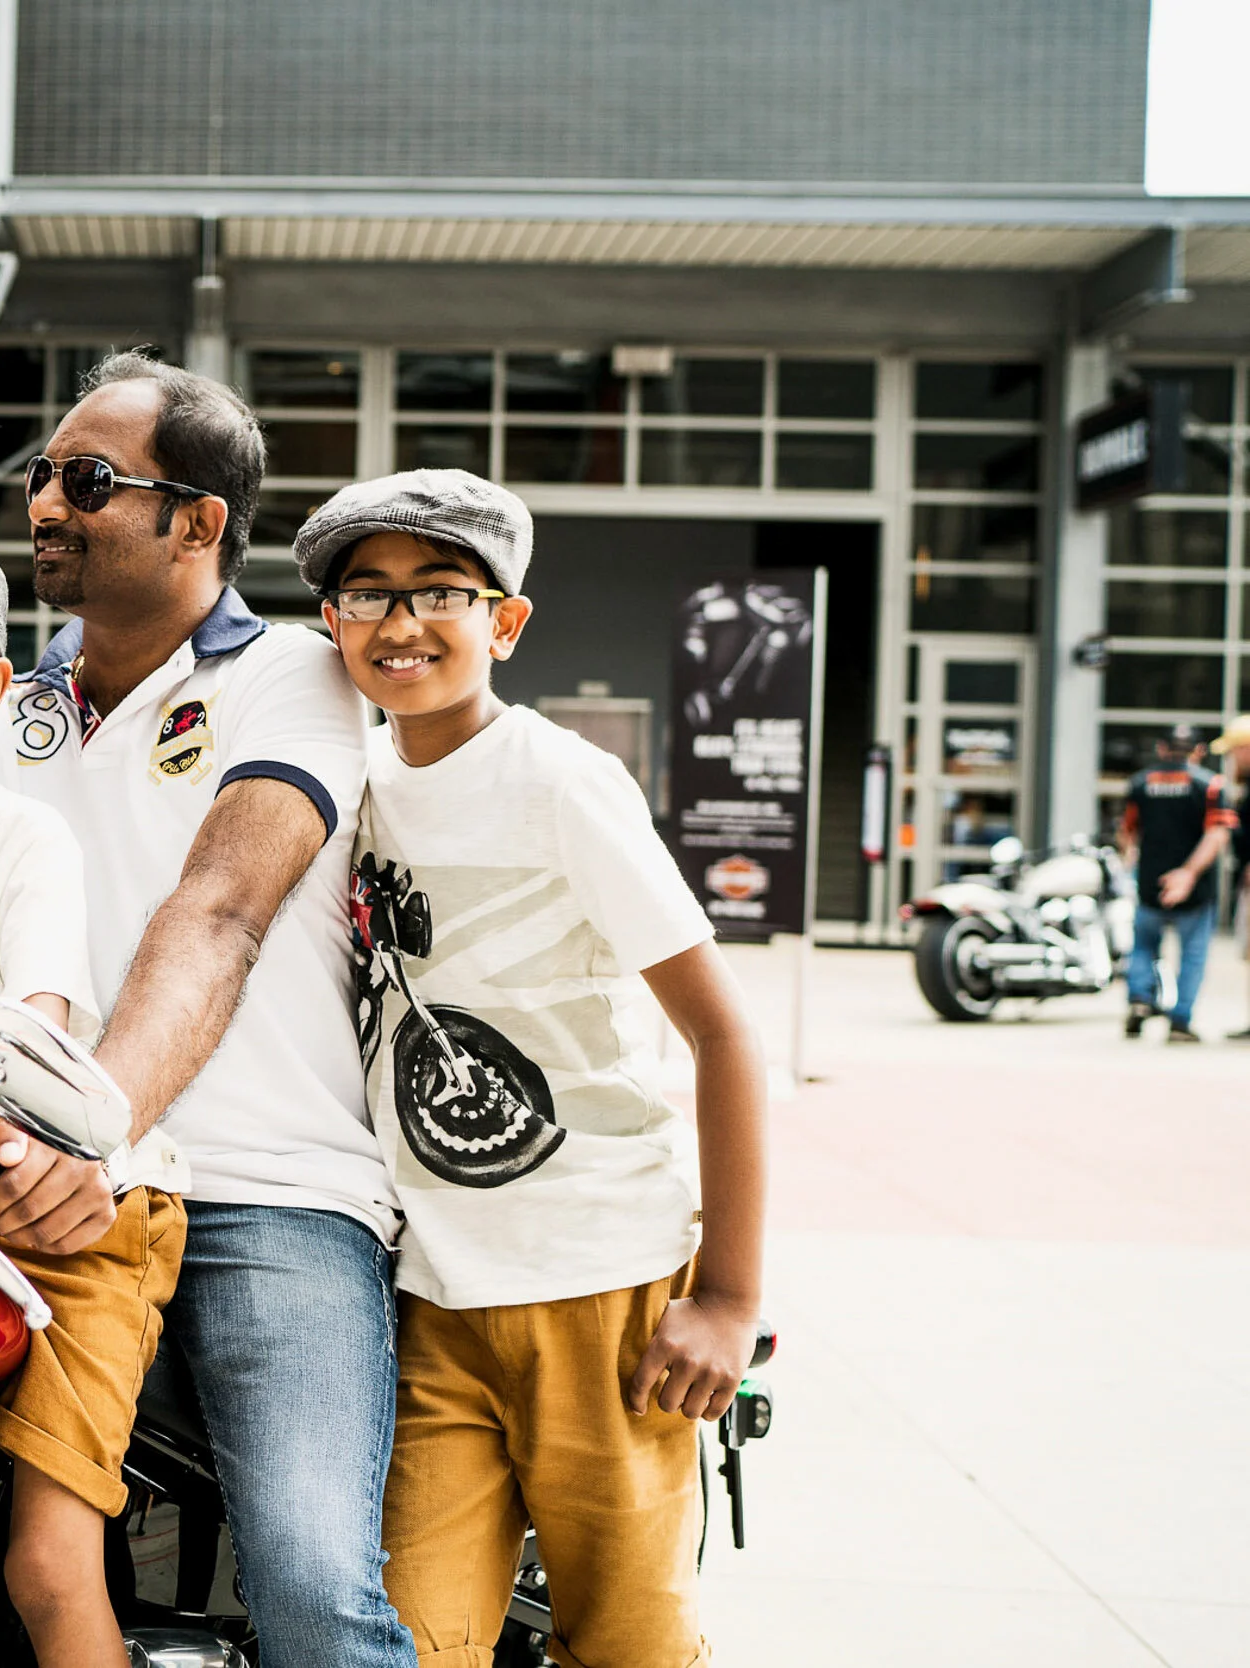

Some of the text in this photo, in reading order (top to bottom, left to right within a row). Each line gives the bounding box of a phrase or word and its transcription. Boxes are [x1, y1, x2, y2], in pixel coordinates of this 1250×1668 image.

[12, 687, 69, 761] 8
[162, 711, 206, 734] 8 2
